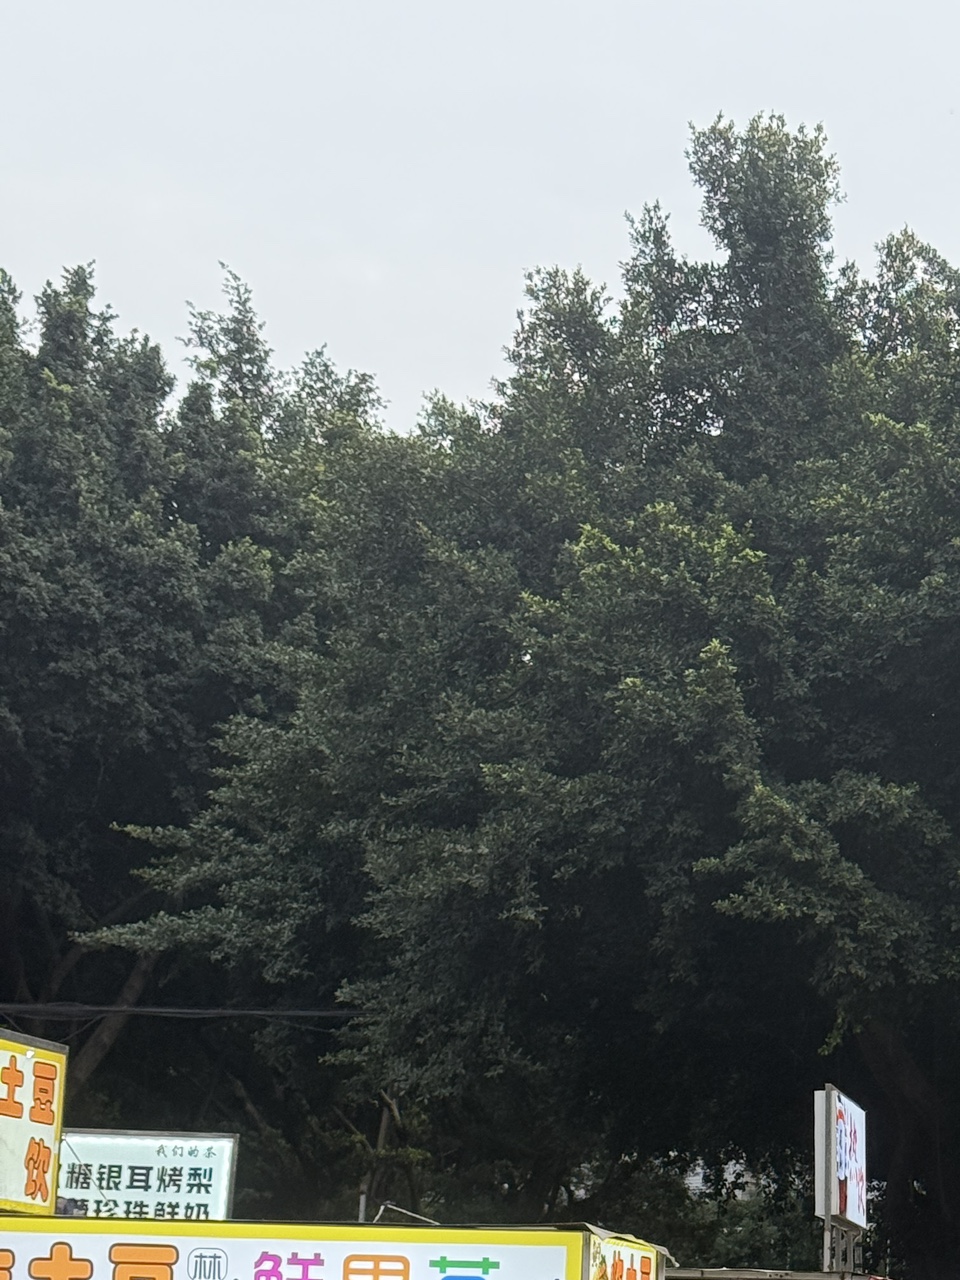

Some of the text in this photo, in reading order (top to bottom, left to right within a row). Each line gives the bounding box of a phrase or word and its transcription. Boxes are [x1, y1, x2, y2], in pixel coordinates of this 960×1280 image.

[155, 1144, 217, 1159] 我们的茶
[25, 1136, 52, 1203] 饮
[57, 1162, 213, 1194] 糖银耳烤梨
